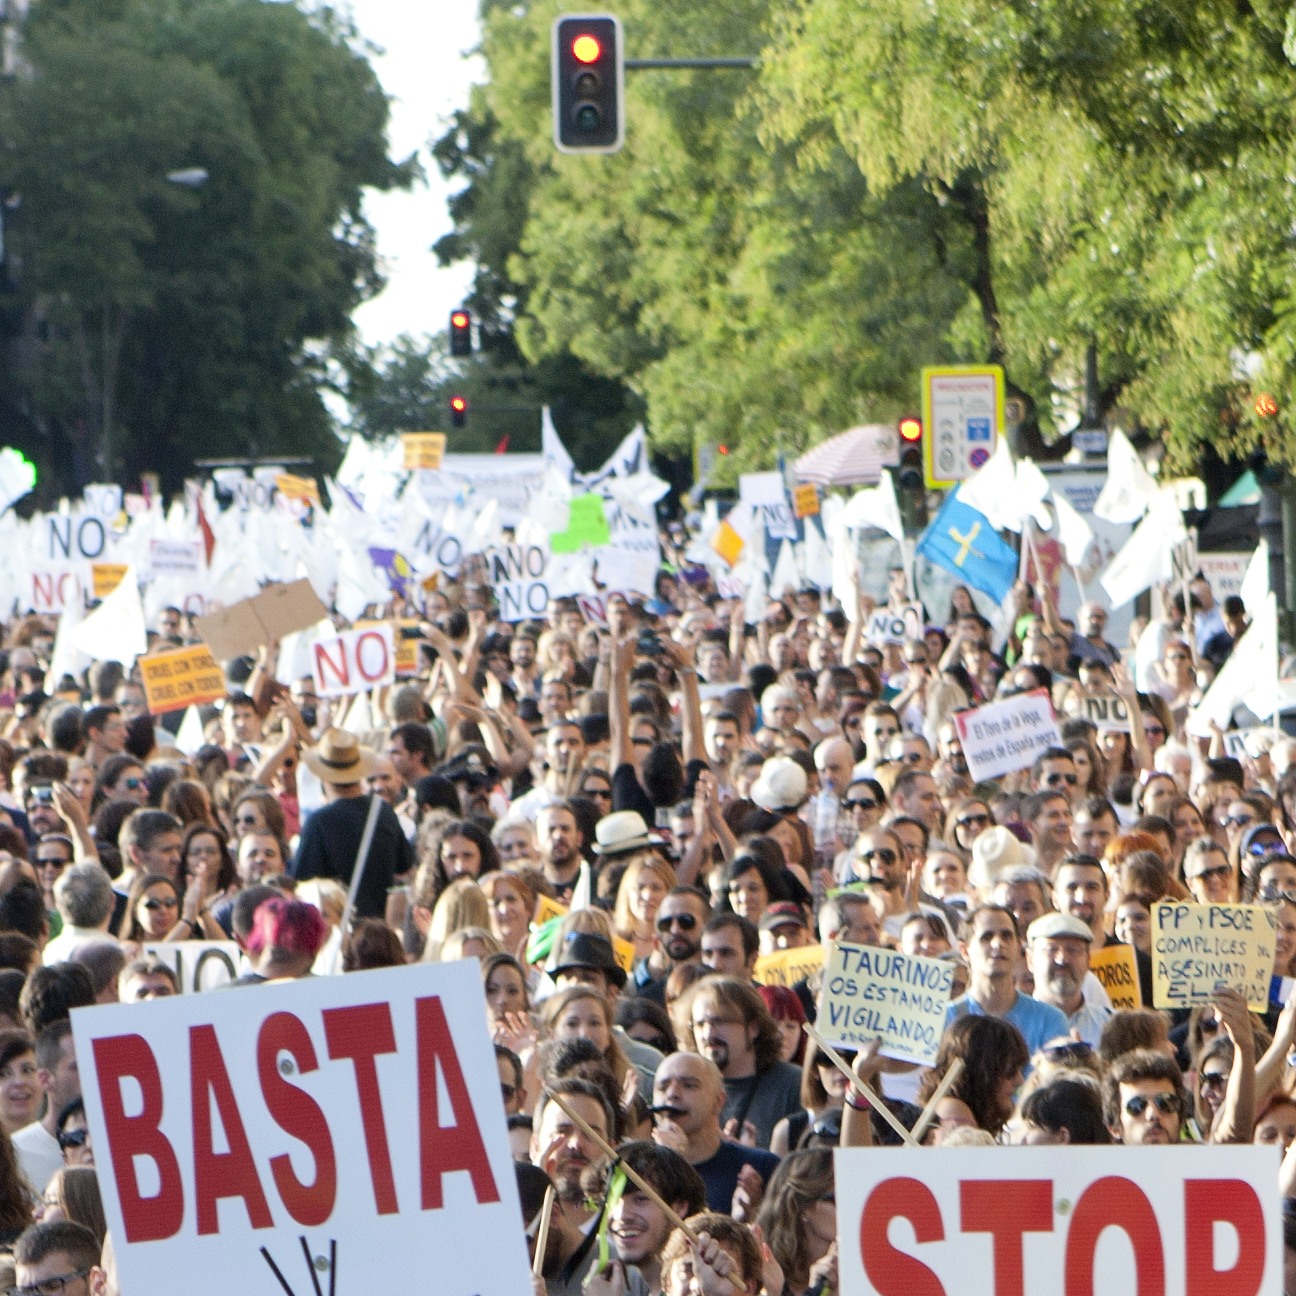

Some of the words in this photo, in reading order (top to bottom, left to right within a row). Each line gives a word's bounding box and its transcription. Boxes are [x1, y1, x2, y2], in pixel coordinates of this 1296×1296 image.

[50, 517, 105, 559] NO
[415, 521, 462, 568] NO
[507, 546, 545, 578] NO
[504, 583, 549, 614] NO
[871, 616, 904, 637] NO
[313, 631, 389, 691] NO
[1157, 905, 1190, 931] PP
[1208, 905, 1254, 931] PSOE
[1155, 936, 1247, 957] COMPLICES
[838, 945, 954, 993] TAURINOS
[1157, 960, 1247, 980] ASESINATO
[829, 976, 858, 997] OS
[863, 983, 943, 1016] ESTAMOS
[91, 994, 502, 1244] BASTA
